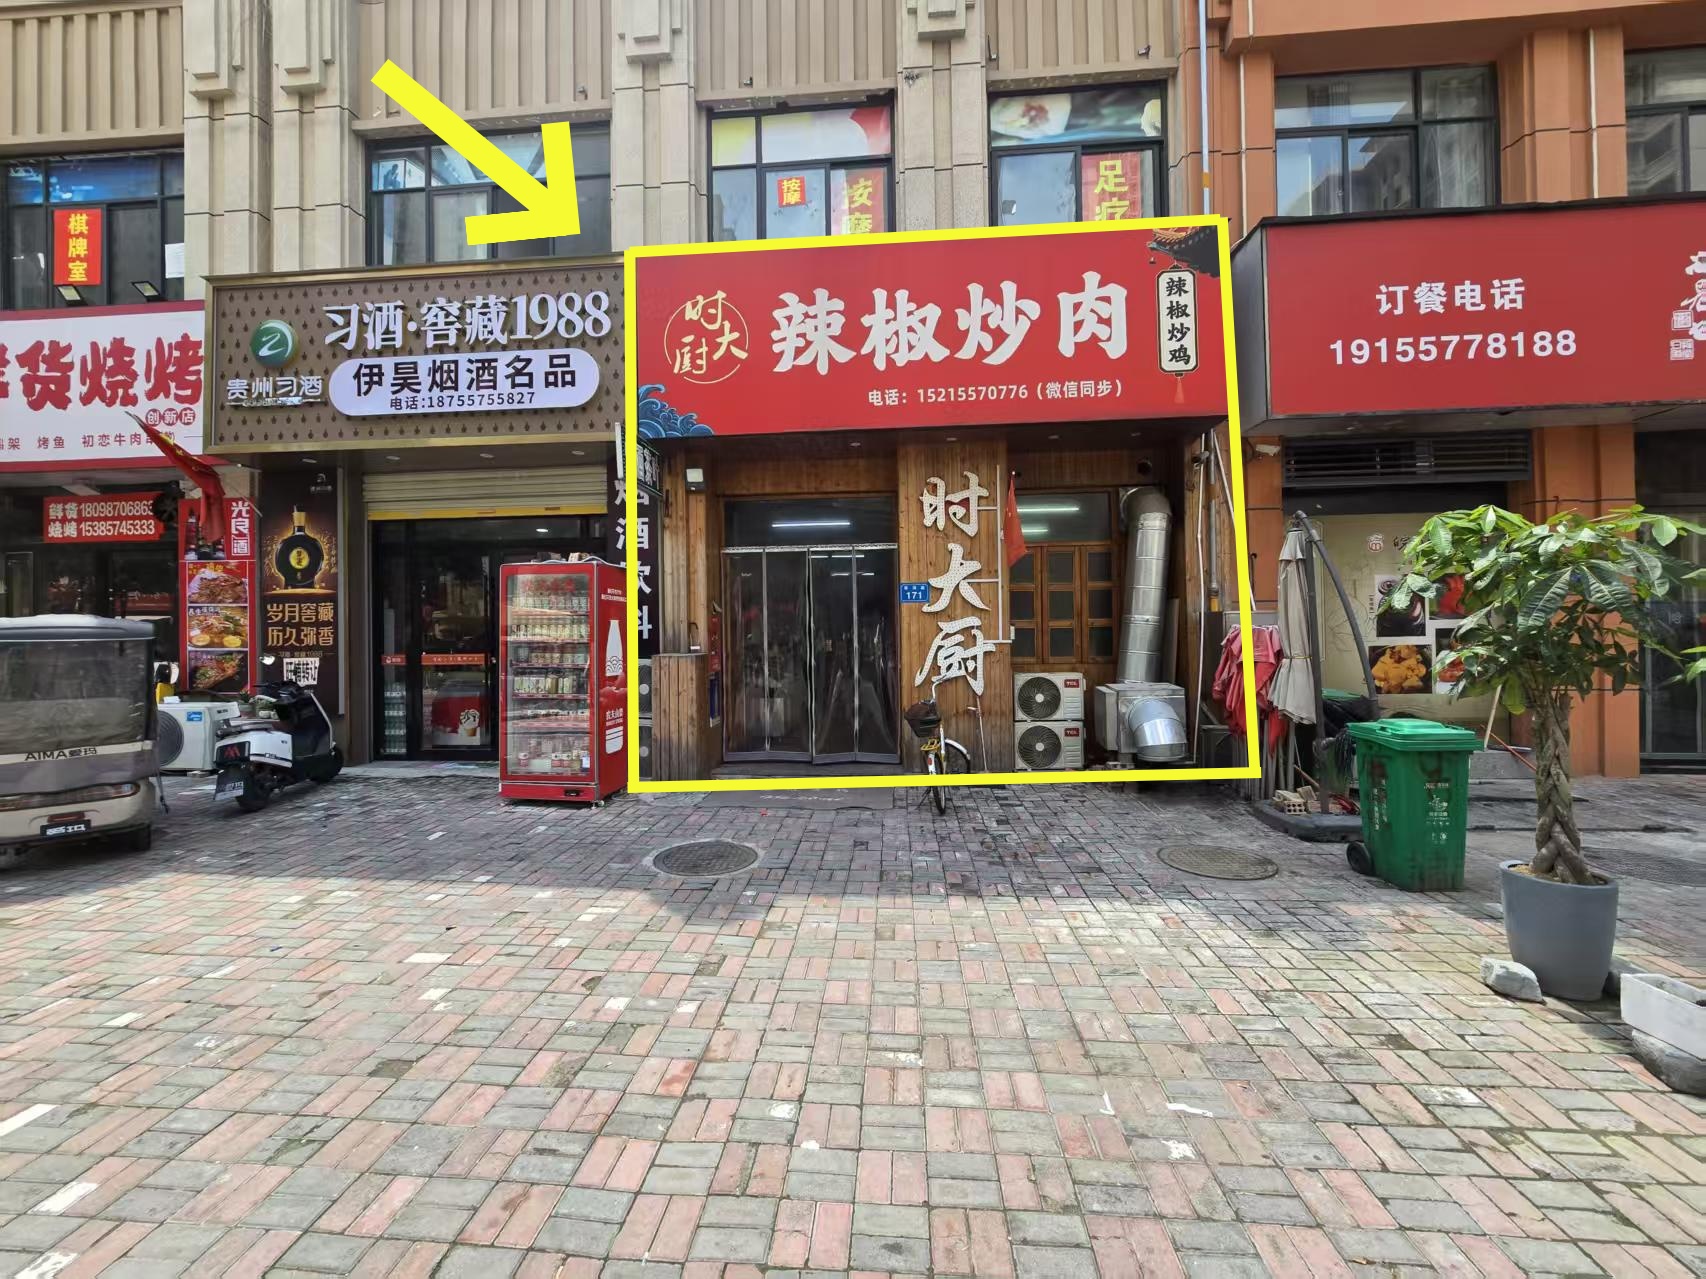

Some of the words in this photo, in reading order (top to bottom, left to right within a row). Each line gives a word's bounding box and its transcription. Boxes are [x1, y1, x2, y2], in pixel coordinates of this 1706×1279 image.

[780, 180, 801, 205] 按摩
[68, 213, 89, 281] 棋牌室
[1376, 278, 1525, 316] 订餐电话
[673, 290, 748, 374] 时大厨
[770, 270, 1128, 375] 辣椒炒肉
[1166, 277, 1191, 365] 辣椒炒鸡
[1330, 330, 1577, 365] 19155778188
[0, 332, 204, 411] 货烧烤
[226, 375, 322, 400] 贵州习酒
[352, 353, 577, 396] 伊昊烟酒名品
[147, 410, 195, 424] 创新店
[37, 436, 65, 449] 烤鱼
[231, 500, 250, 556] 光良酒
[906, 591, 922, 600] 171
[915, 471, 996, 696] 时大厨
[267, 603, 334, 622] 岁月窖藏
[267, 626, 334, 646] 历久弥香
